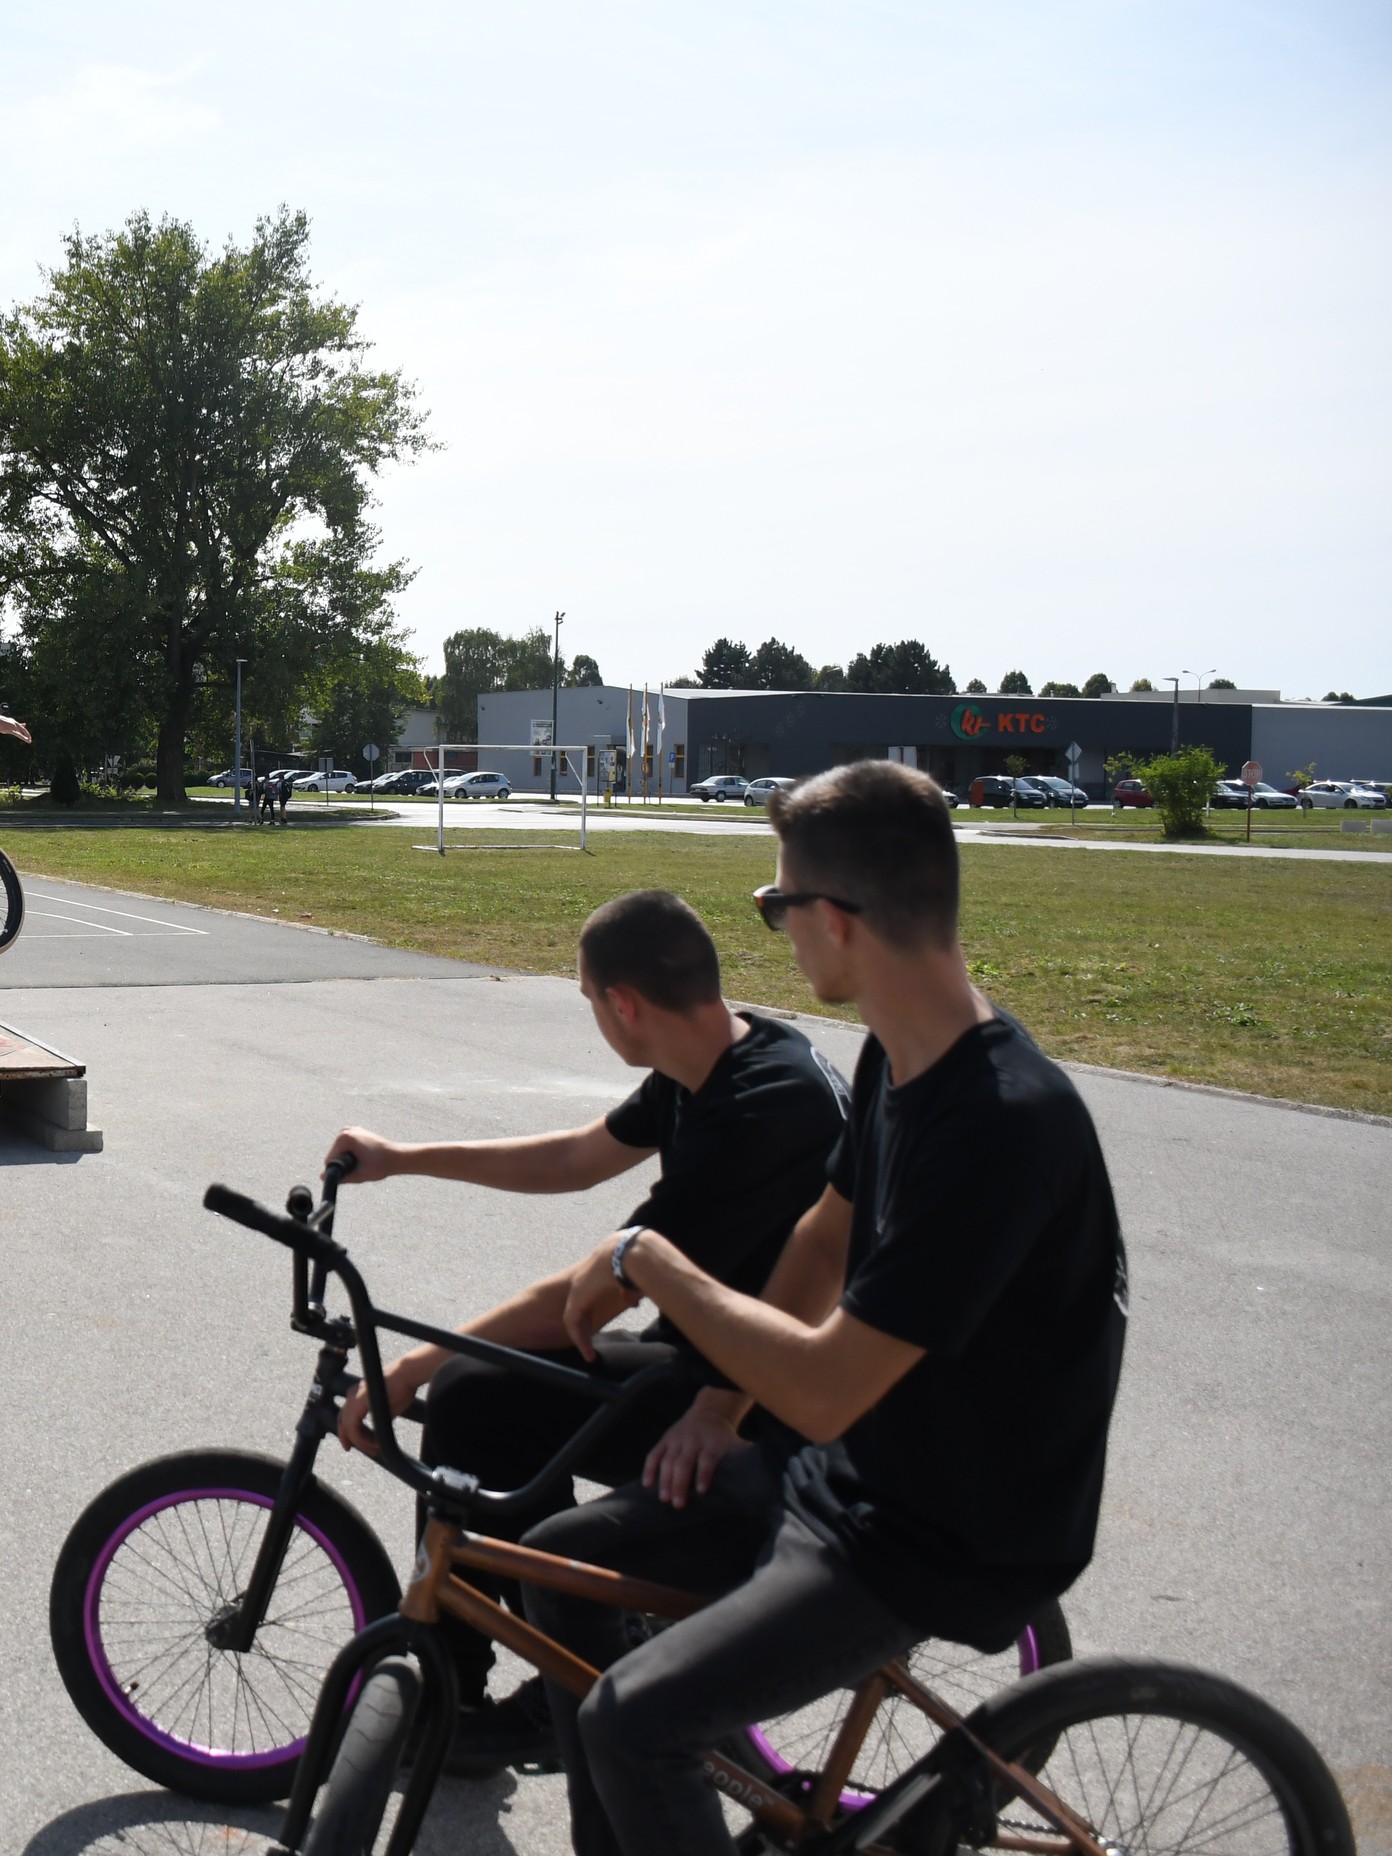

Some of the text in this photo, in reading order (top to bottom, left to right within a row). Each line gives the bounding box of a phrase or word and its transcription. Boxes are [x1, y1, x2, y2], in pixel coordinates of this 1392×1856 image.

[998, 713, 1045, 733] KTC
[1243, 768, 1261, 778] STOP
[703, 1760, 764, 1809] eople
